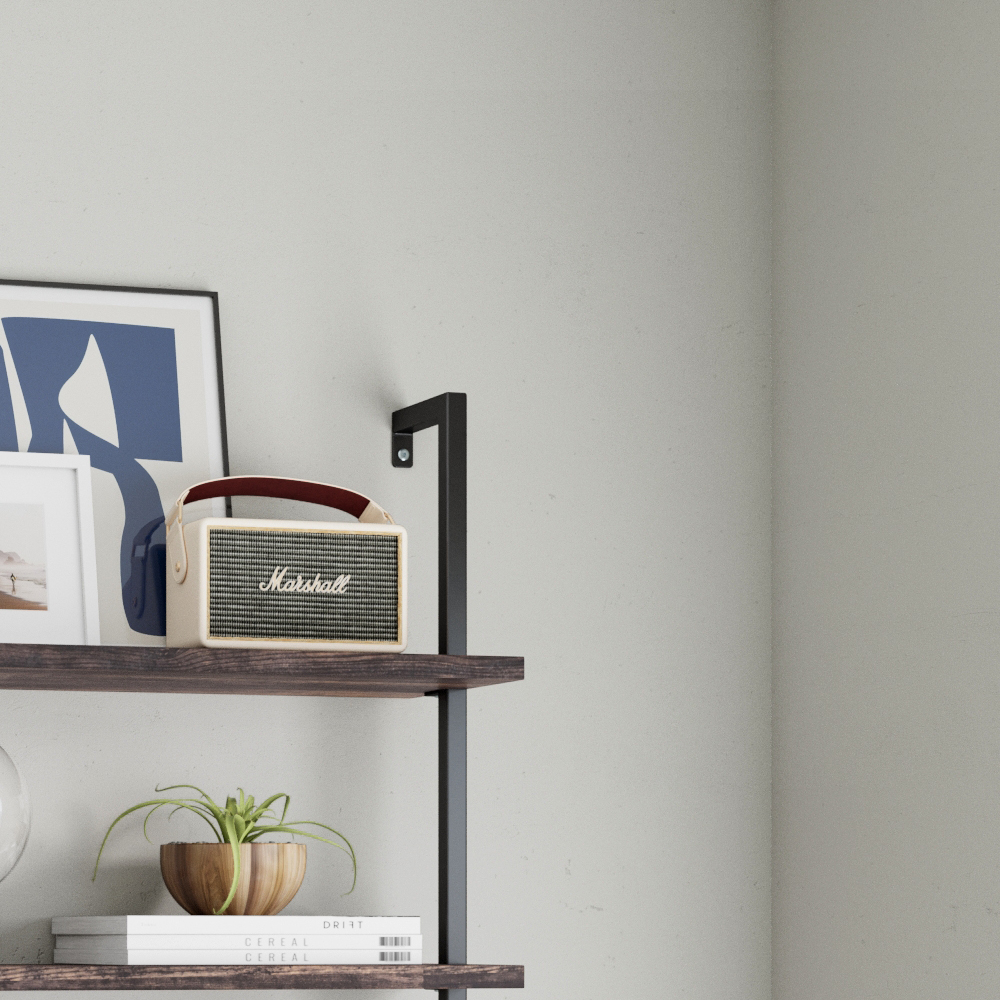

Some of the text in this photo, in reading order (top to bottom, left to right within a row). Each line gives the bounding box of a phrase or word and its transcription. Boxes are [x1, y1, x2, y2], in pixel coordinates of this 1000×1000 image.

[259, 566, 351, 593] Marshall
[245, 938, 308, 947] CEREAL
[245, 953, 308, 962] CEREAL
